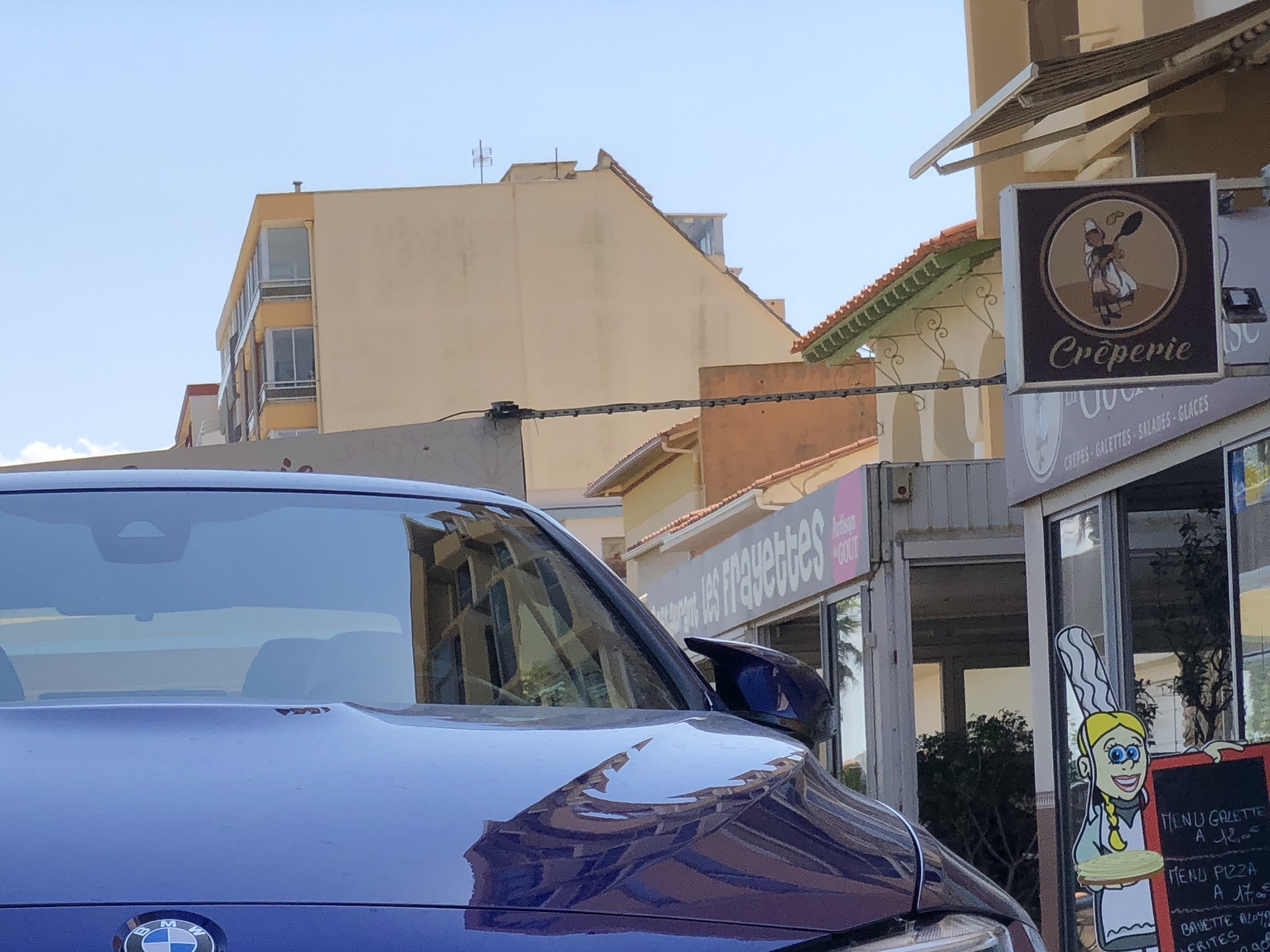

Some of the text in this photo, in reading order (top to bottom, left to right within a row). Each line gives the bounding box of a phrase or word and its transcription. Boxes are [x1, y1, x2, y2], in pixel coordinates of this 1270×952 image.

[1049, 336, 1191, 372] Crêperie
[1096, 428, 1132, 457] GALETTES
[1138, 411, 1171, 440] SALADES
[1178, 394, 1209, 422] GLACES
[1161, 806, 1266, 833] MENU GALETTE
[1168, 862, 1259, 886] MENU PIZZA
[133, 920, 206, 937] BMW
